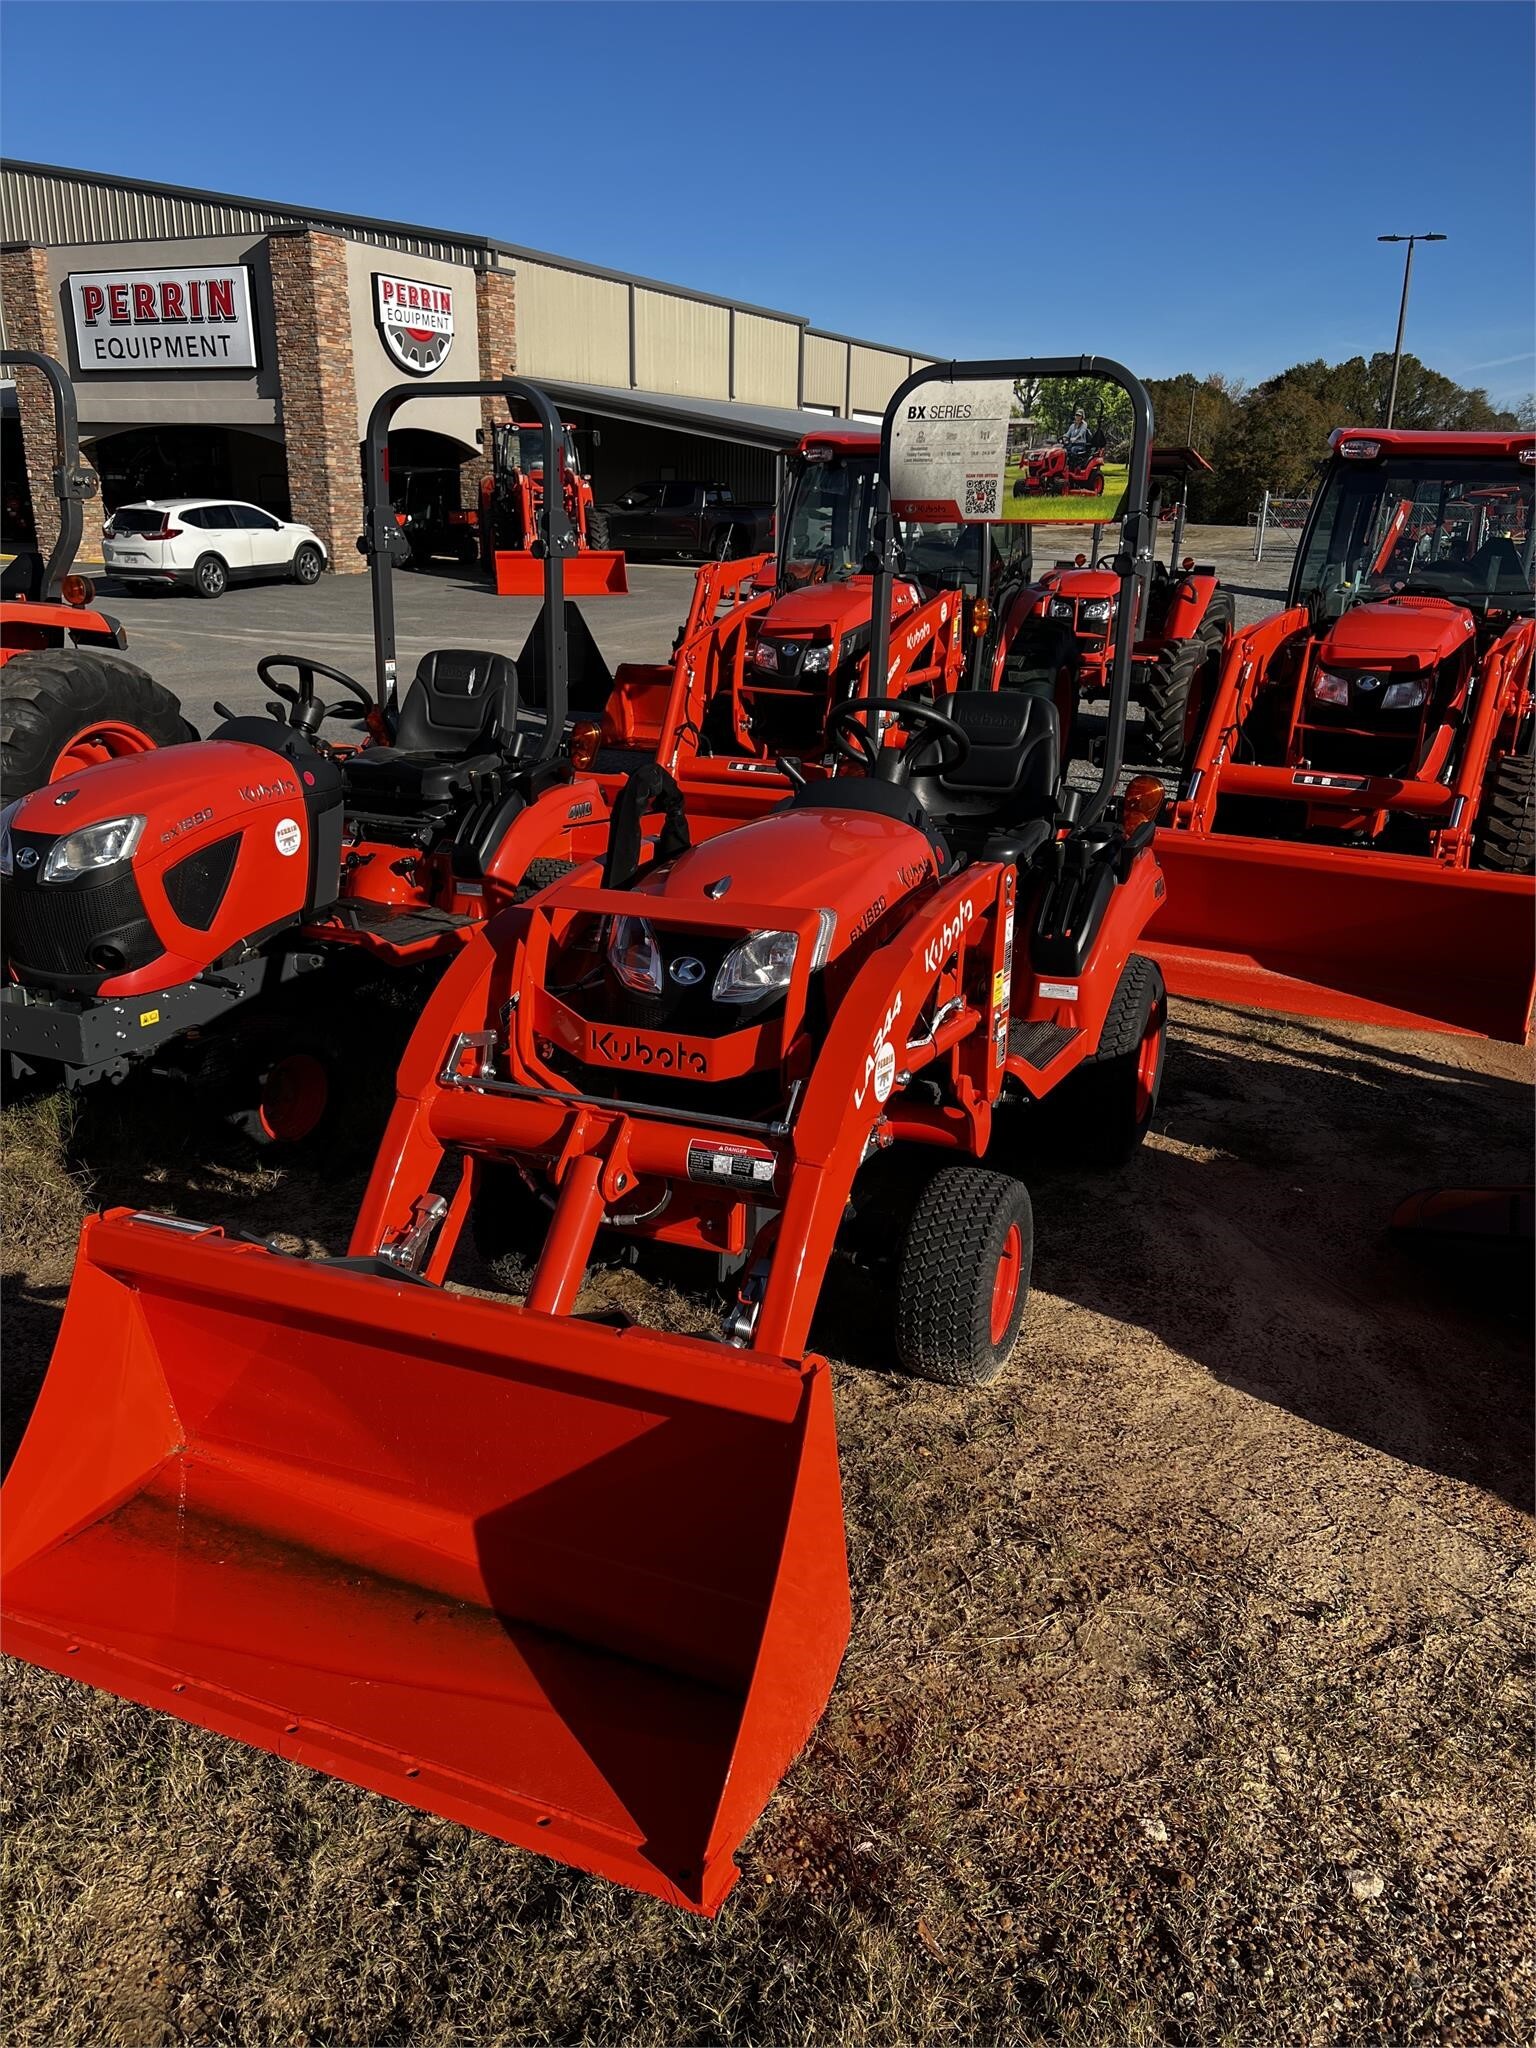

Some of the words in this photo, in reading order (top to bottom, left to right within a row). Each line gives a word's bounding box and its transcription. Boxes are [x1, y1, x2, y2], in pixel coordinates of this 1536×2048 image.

[80, 279, 239, 327] PERRIN
[382, 280, 452, 315] PERRIN
[387, 308, 449, 329] EQUIPMENT
[94, 335, 231, 359] EQUIPMENT
[907, 406, 926, 419] BX
[929, 404, 972, 419] SERIES
[906, 622, 930, 650] Kubota
[238, 777, 297, 804] Kubota
[925, 899, 973, 973] Kubota
[591, 1029, 708, 1073] Kubota
[724, 1146, 748, 1154] DANGER
